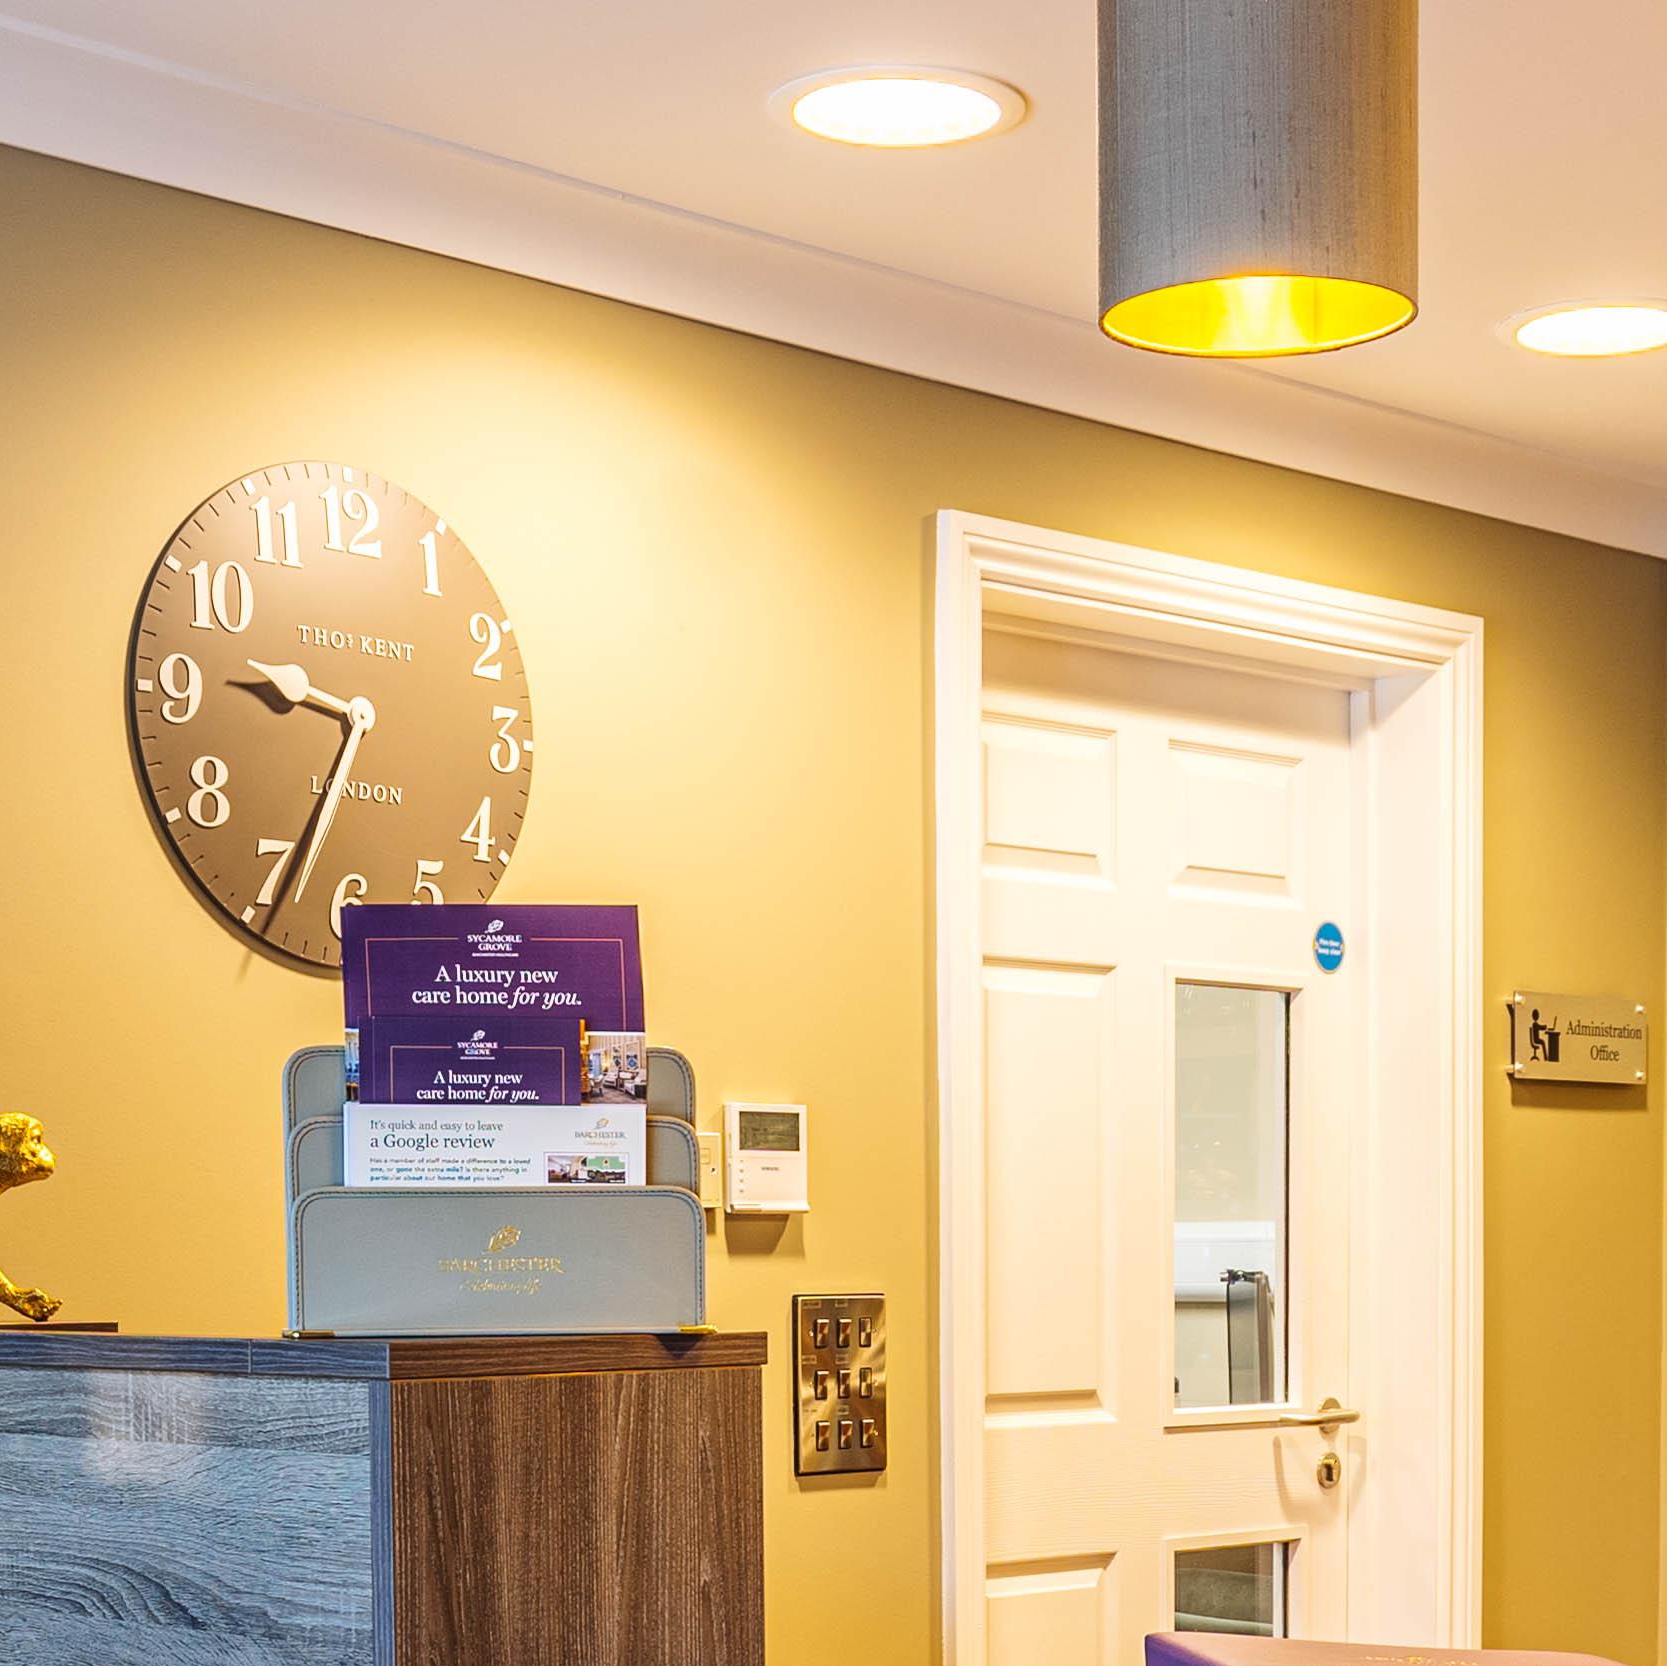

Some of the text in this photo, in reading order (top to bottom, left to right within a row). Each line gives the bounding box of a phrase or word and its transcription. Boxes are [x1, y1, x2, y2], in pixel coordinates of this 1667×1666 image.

[250, 495, 304, 568] 11
[319, 485, 382, 559] 12
[418, 531, 443, 597] 1
[186, 559, 254, 634] 10
[360, 635, 414, 662] KENT
[469, 612, 503, 681] 2
[158, 653, 203, 726] 9
[489, 705, 521, 774] 3
[186, 755, 231, 828] 8
[460, 796, 496, 862] 4
[256, 838, 297, 905] 7
[411, 859, 444, 905] 5
[467, 934, 522, 943] SYCAMORE
[478, 943, 512, 951] GROVE
[435, 965, 558, 987] A luxury new
[412, 986, 582, 1010] care home for you.
[1566, 1020, 1642, 1040] Administration
[1590, 1045, 1620, 1061] Office
[416, 1086, 540, 1104] care home for you.
[433, 1070, 523, 1087] A luxury new
[370, 1119, 504, 1132] It's quick and easy to leave
[370, 1133, 495, 1151] a Google review
